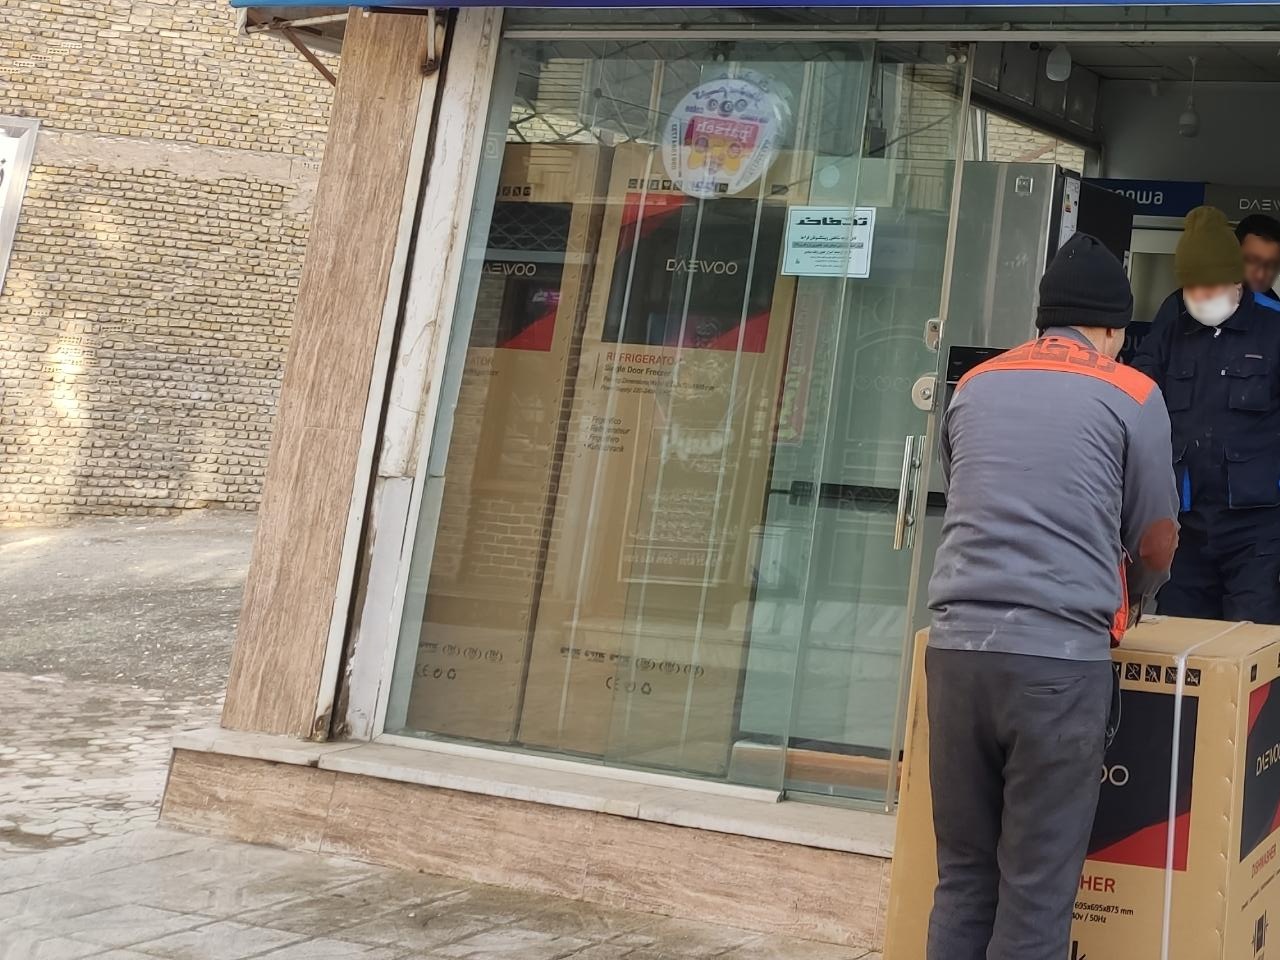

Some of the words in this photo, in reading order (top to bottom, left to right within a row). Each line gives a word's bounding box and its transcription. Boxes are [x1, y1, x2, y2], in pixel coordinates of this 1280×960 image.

[1113, 189, 1164, 205] owa
[481, 262, 537, 277] AEWOO
[665, 258, 738, 275] DAEWOO
[606, 351, 683, 366] RFRIGERATO
